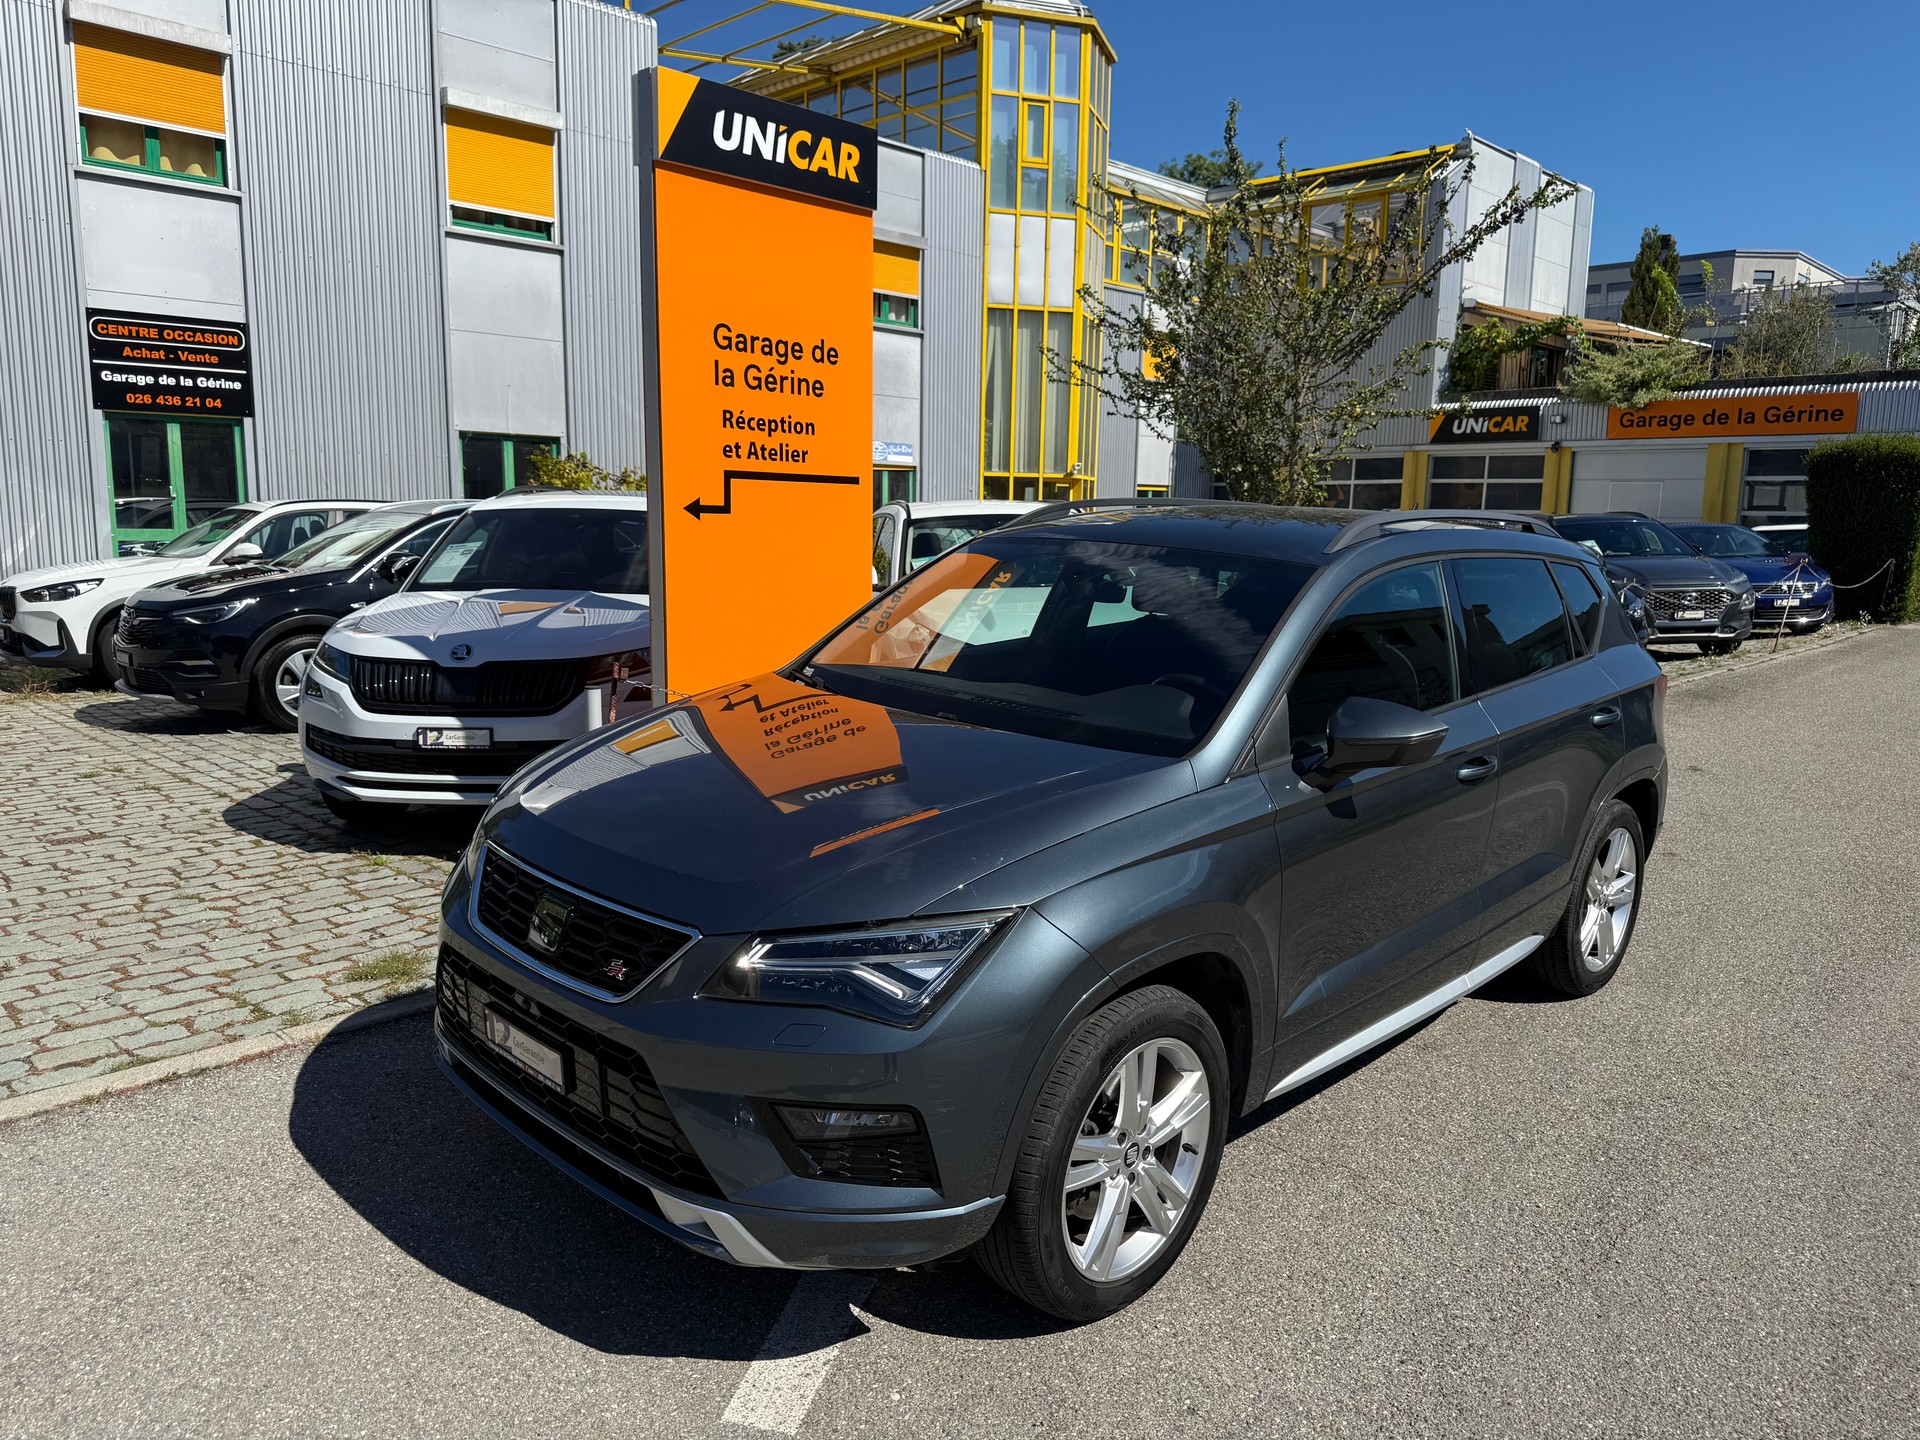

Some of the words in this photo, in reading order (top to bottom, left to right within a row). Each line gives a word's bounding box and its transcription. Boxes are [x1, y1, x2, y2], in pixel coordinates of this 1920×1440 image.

[96, 322, 159, 340] CENTRE
[163, 329, 239, 346] OCCASION
[712, 322, 804, 366] Garage
[811, 338, 840, 366] de
[122, 346, 166, 360] Achat
[178, 350, 219, 364] Vente
[100, 370, 155, 386] Garage
[158, 374, 177, 387] de
[180, 375, 193, 387] la
[196, 376, 242, 390] Gérine
[713, 359, 735, 388] la
[743, 363, 825, 398] Gérine
[126, 392, 152, 405] 026
[156, 395, 182, 407] 436
[185, 397, 201, 407] 21
[205, 397, 222, 409] 04
[721, 409, 816, 437] Réception
[1618, 408, 1696, 432] Garage
[1702, 408, 1730, 427] de
[1737, 406, 1755, 425] la
[1762, 403, 1845, 424] Gérine
[722, 441, 742, 459] et
[747, 441, 809, 463] Atelier
